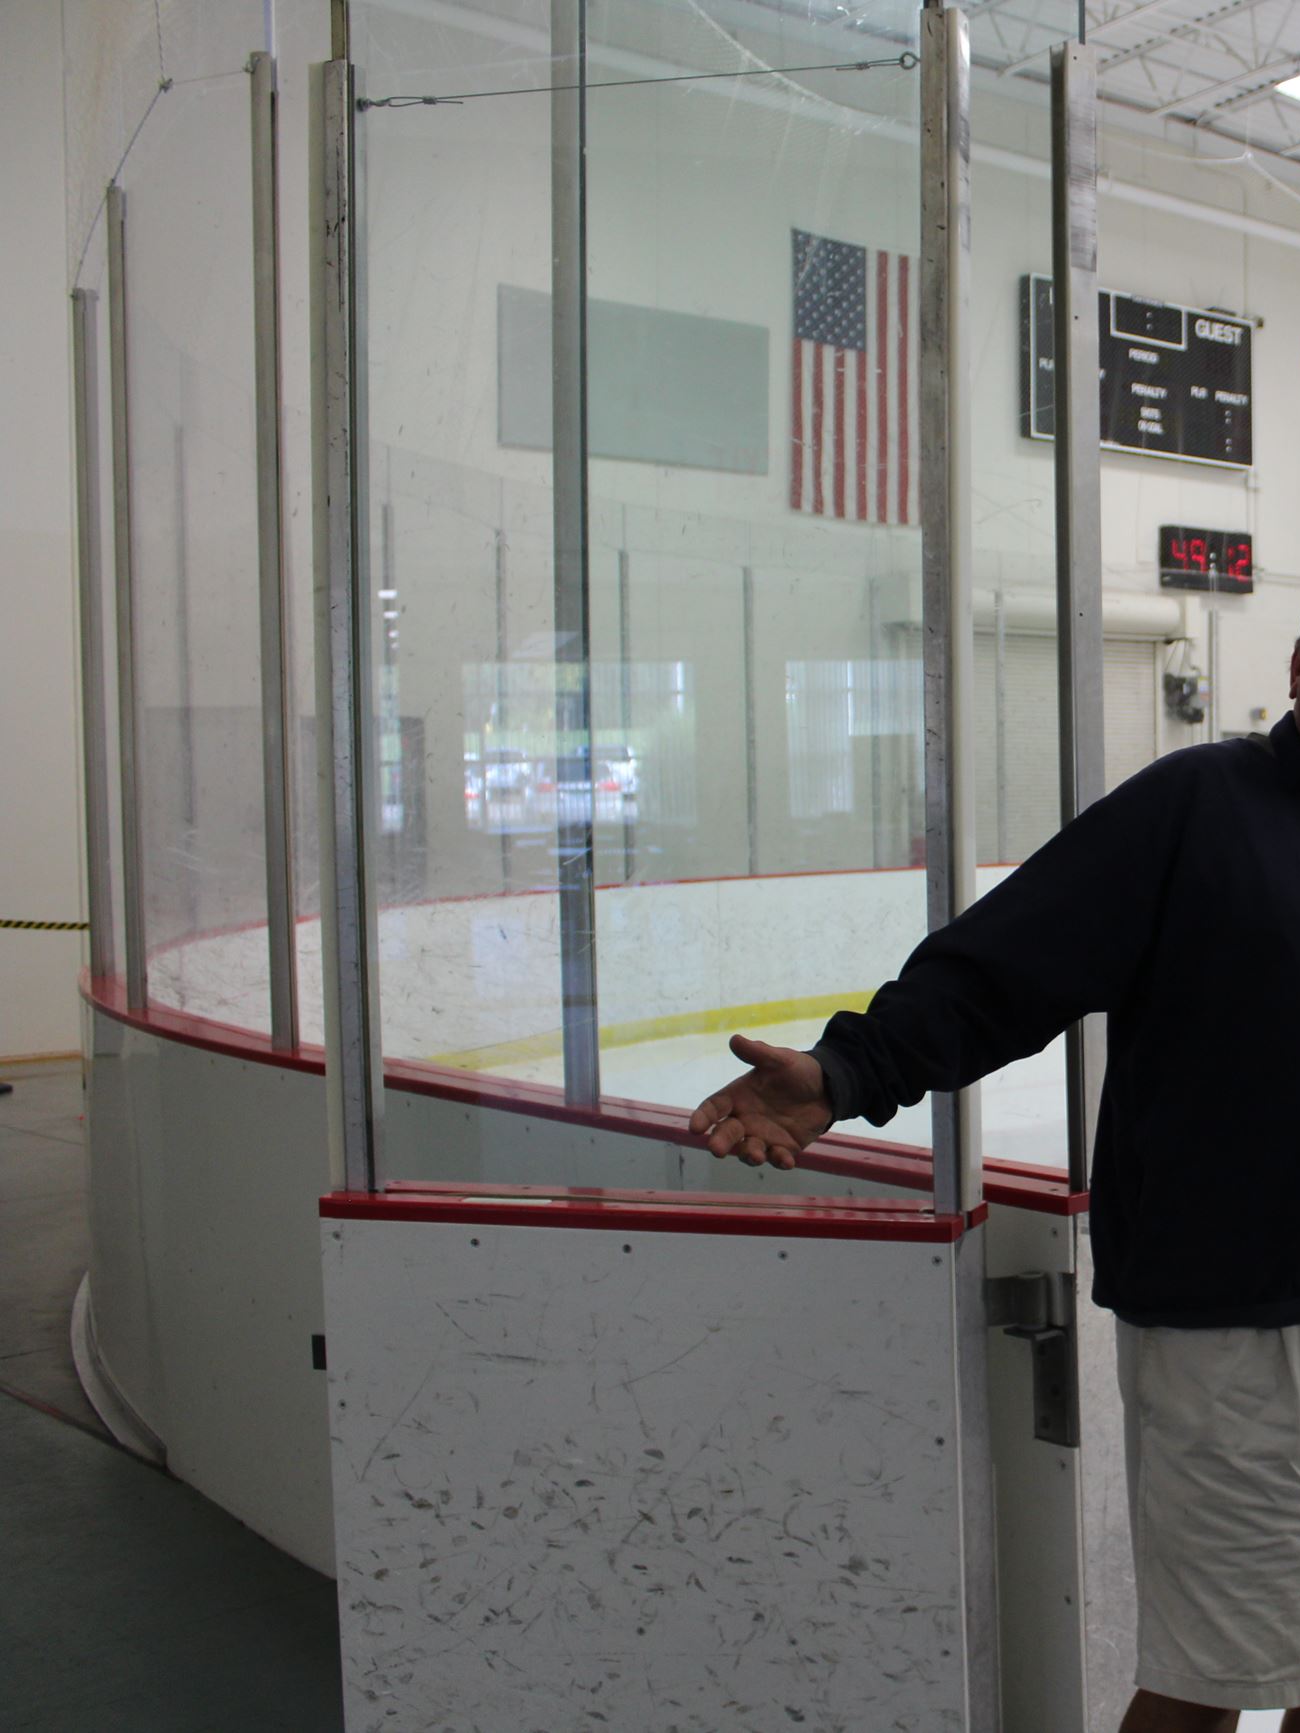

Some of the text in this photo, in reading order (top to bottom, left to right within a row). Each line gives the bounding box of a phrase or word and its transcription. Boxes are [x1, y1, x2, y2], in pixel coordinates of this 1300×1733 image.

[1195, 318, 1242, 345] GUEST
[1131, 382, 1167, 398] PENALTY
[1215, 390, 1247, 405] PENALTY
